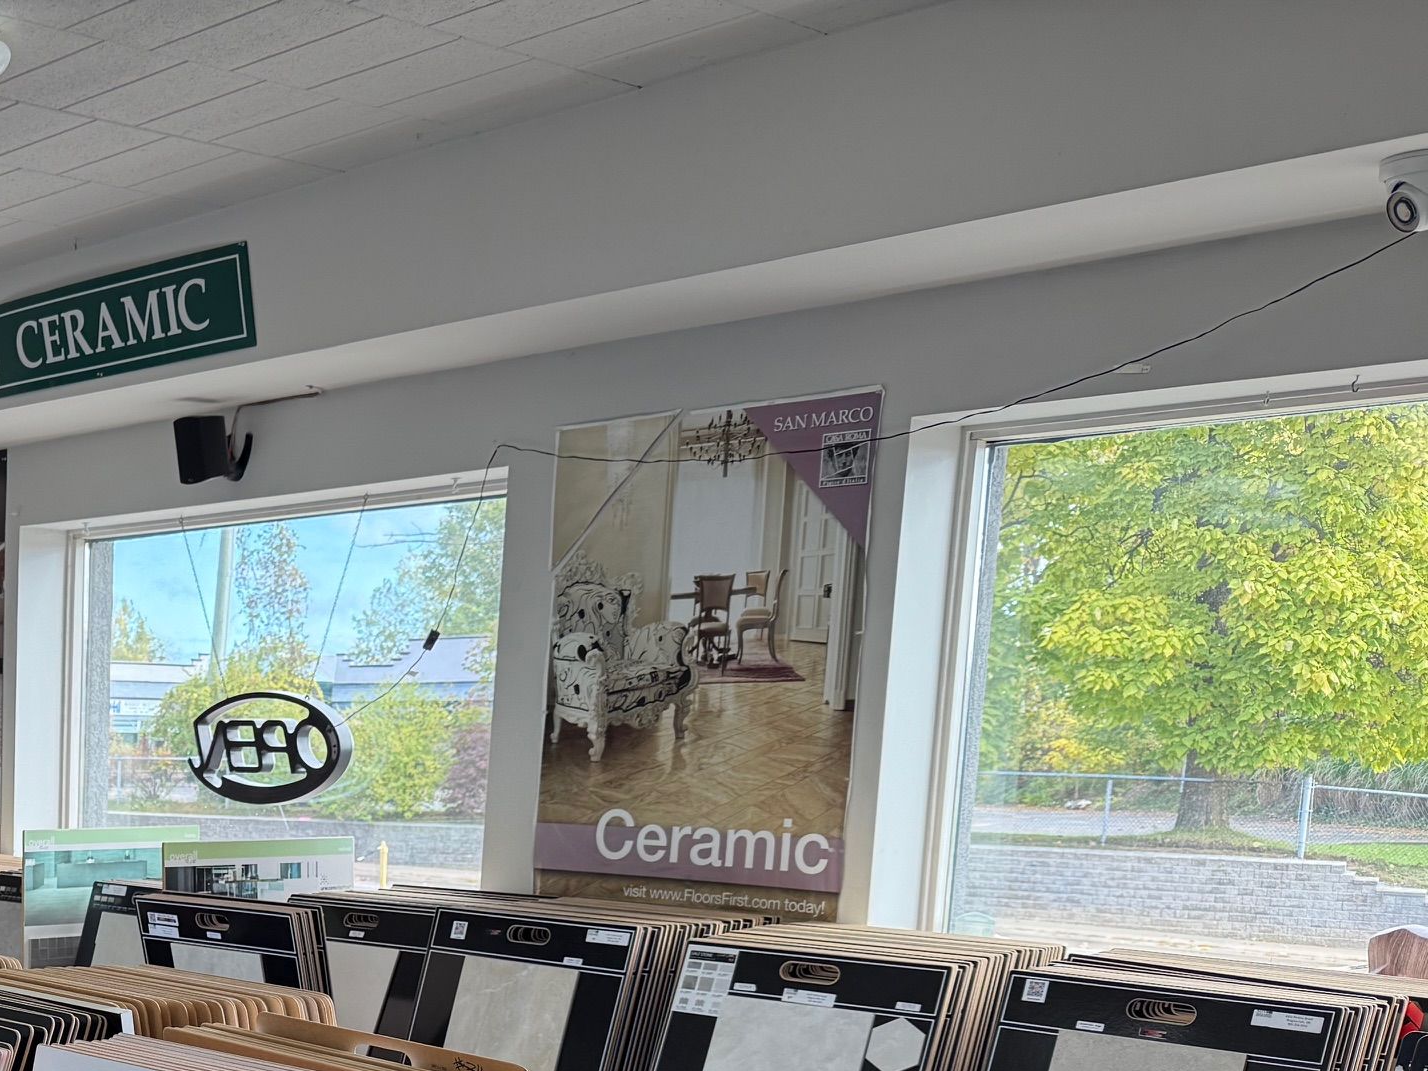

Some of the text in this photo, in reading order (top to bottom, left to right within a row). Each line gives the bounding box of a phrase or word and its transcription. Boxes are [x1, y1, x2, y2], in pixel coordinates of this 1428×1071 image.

[16, 278, 210, 368] CERAMIC
[774, 406, 874, 433] SAN MARCO
[825, 431, 867, 443] CASA ROMA
[595, 808, 830, 875] Ceramic
[623, 884, 826, 918] visit www.FloorsFirst.com today!
